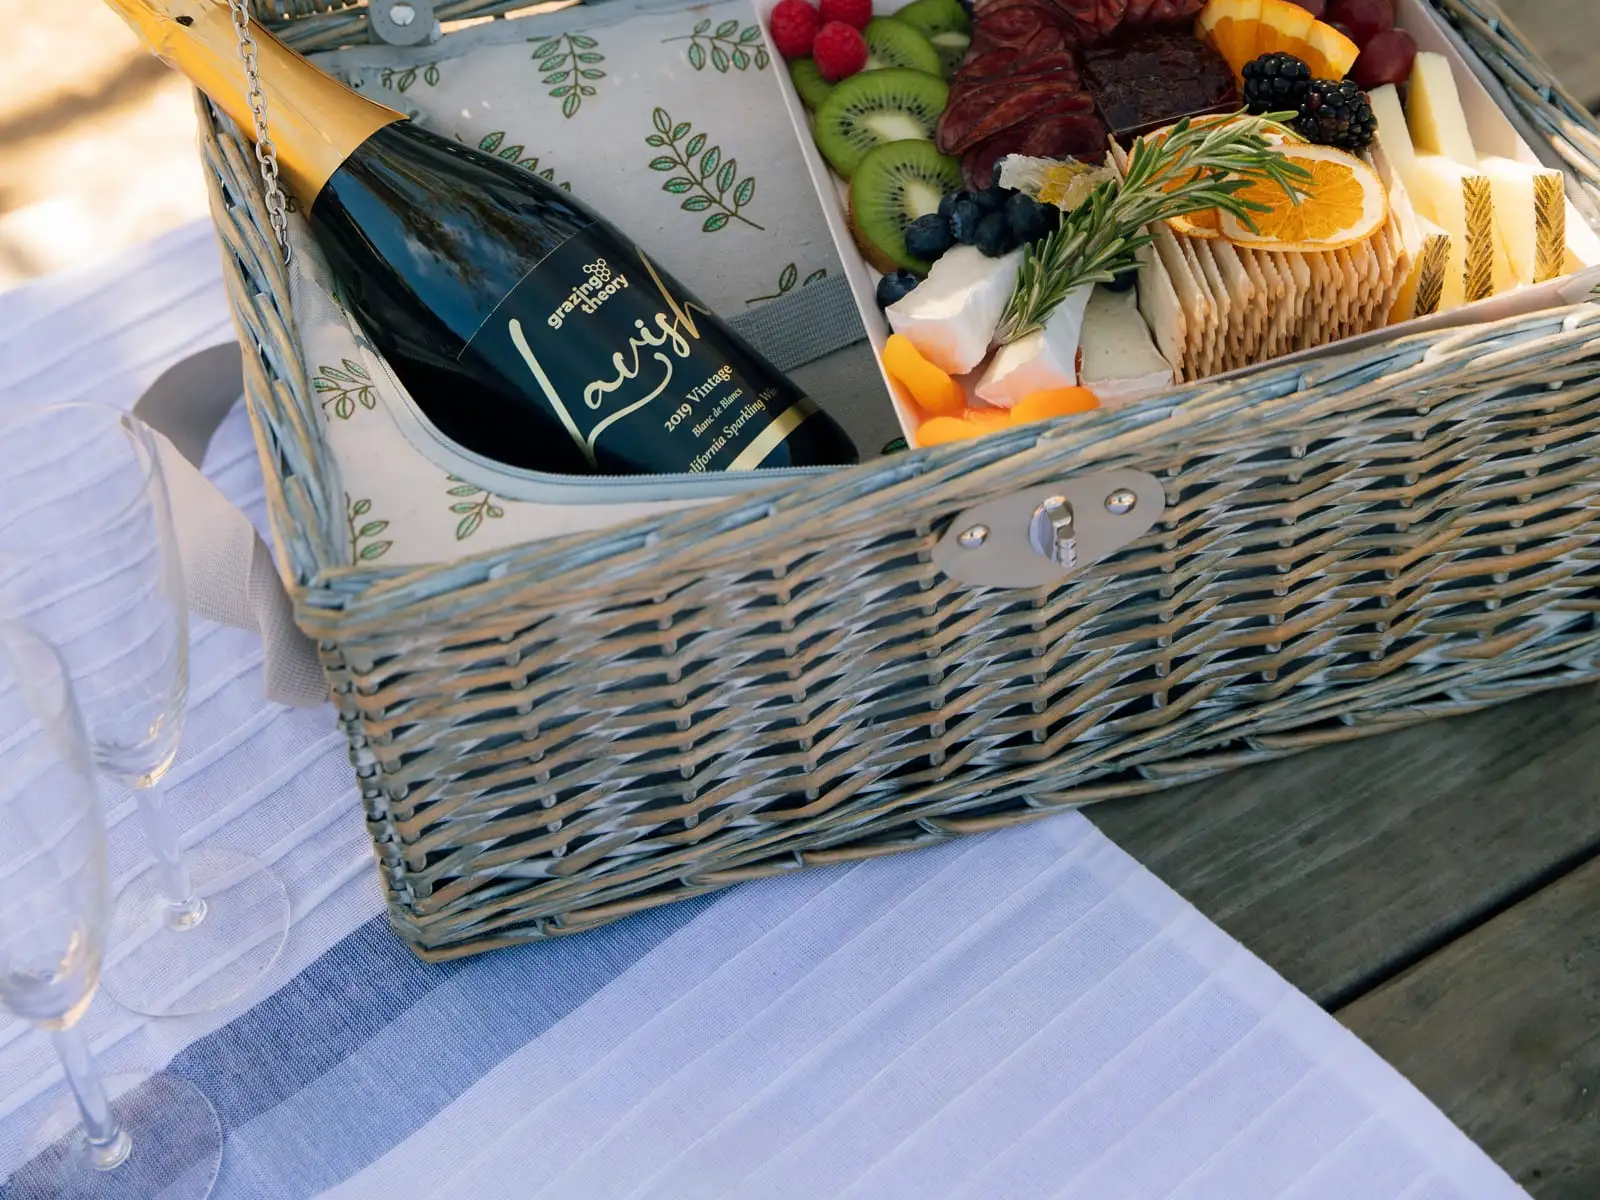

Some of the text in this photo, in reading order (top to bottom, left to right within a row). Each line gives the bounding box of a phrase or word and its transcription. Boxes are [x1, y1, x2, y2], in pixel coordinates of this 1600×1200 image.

[547, 275, 603, 330] grazing
[581, 274, 629, 314] theory
[508, 246, 712, 468] Lavish
[664, 365, 733, 433] 2019 Vintage
[692, 387, 743, 438] Blanc de Blancs
[723, 398, 766, 440] Sparkling
